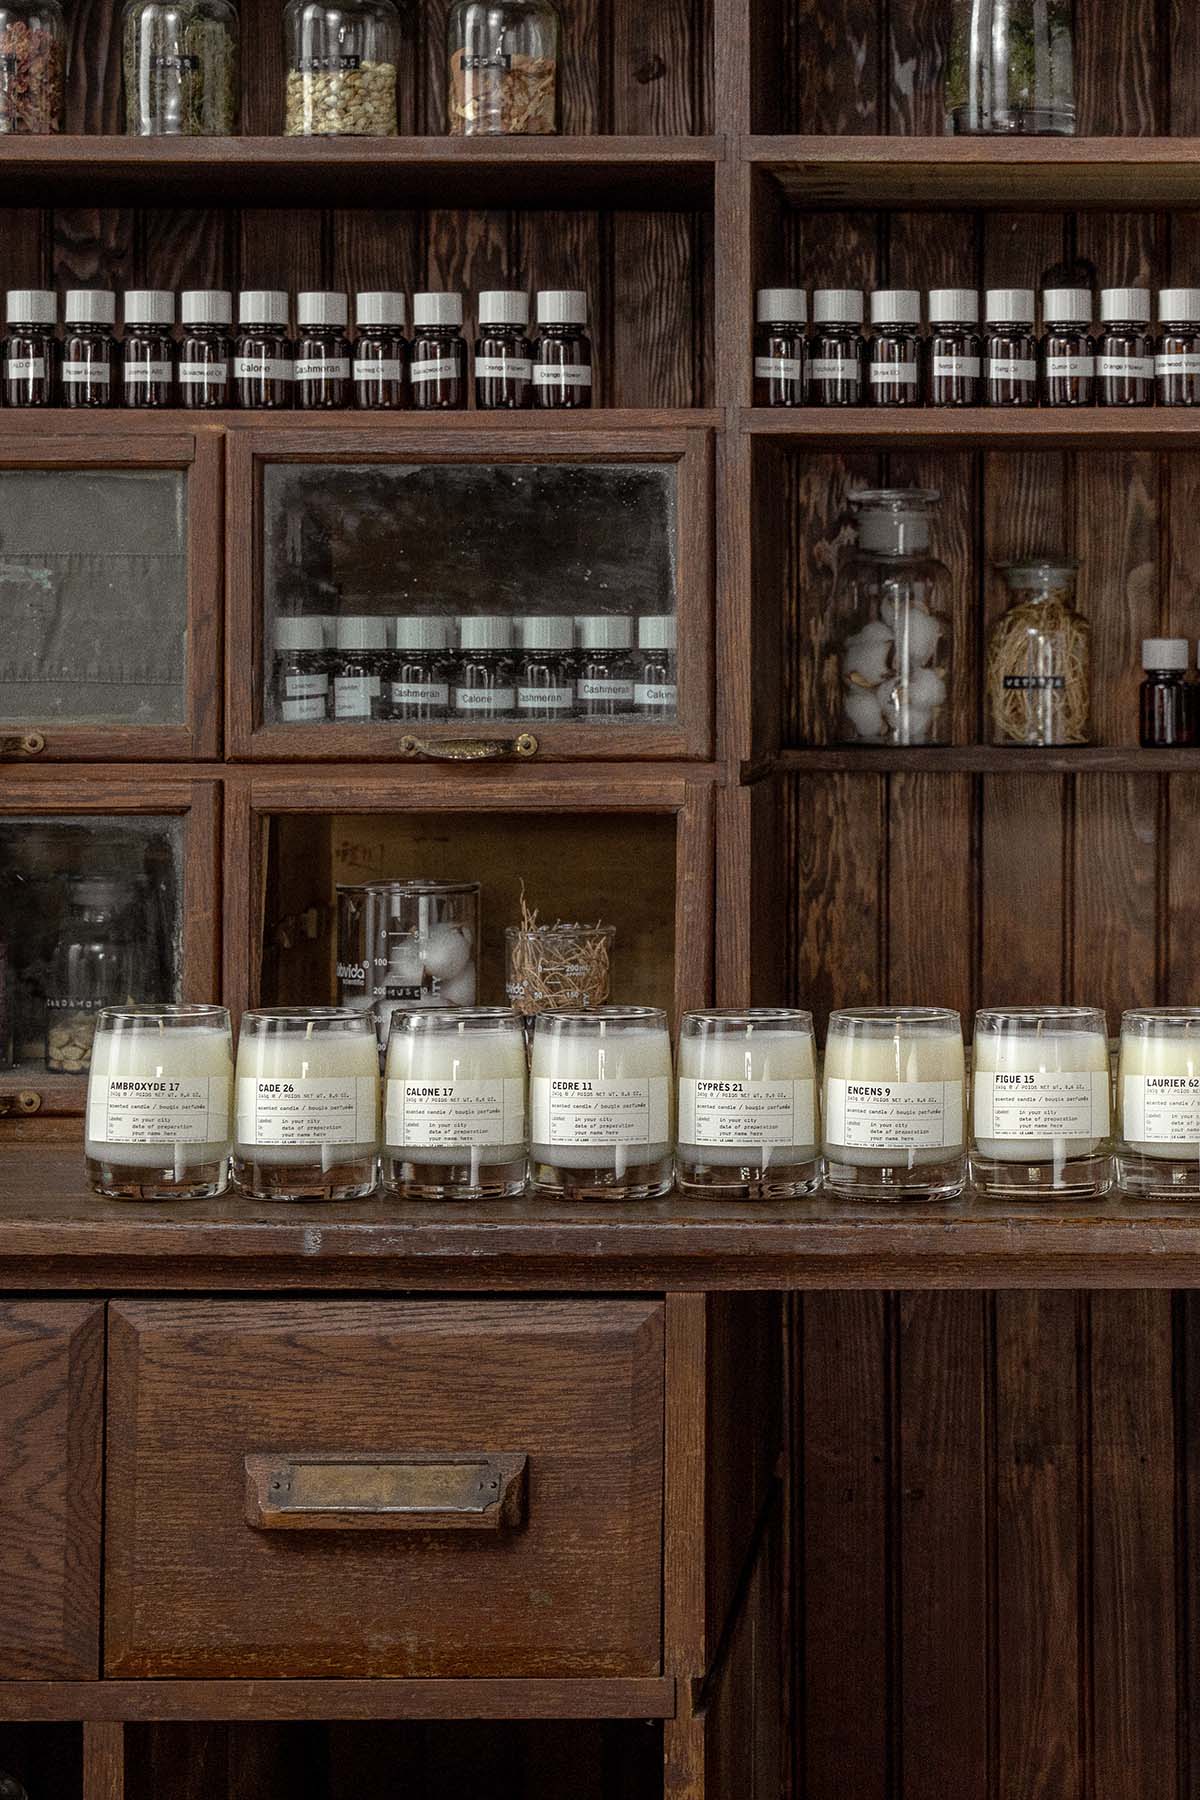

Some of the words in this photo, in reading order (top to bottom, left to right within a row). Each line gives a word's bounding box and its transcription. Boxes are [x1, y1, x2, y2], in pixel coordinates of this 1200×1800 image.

[240, 363, 270, 373] Calone
[394, 689, 440, 698] Cashmeran
[462, 694, 492, 703] Calone
[374, 958, 388, 966] 100
[995, 1075, 1021, 1083] FIGUE
[1024, 1075, 1035, 1083] 15
[1147, 1079, 1186, 1087] LAURIER
[1188, 1079, 1200, 1088] 62
[110, 1082, 166, 1091] AMBROXYDE
[169, 1083, 180, 1091] 17
[259, 1084, 281, 1092] CADE
[283, 1084, 294, 1092] 26
[552, 1081, 579, 1090] CEDRE
[582, 1082, 593, 1090] 11
[697, 1081, 730, 1092] CYPRÈS
[732, 1083, 743, 1092] 21
[406, 1087, 440, 1096] CALONE
[443, 1088, 454, 1096] 17
[847, 1086, 883, 1096] ENCENS
[885, 1087, 891, 1096] 9
